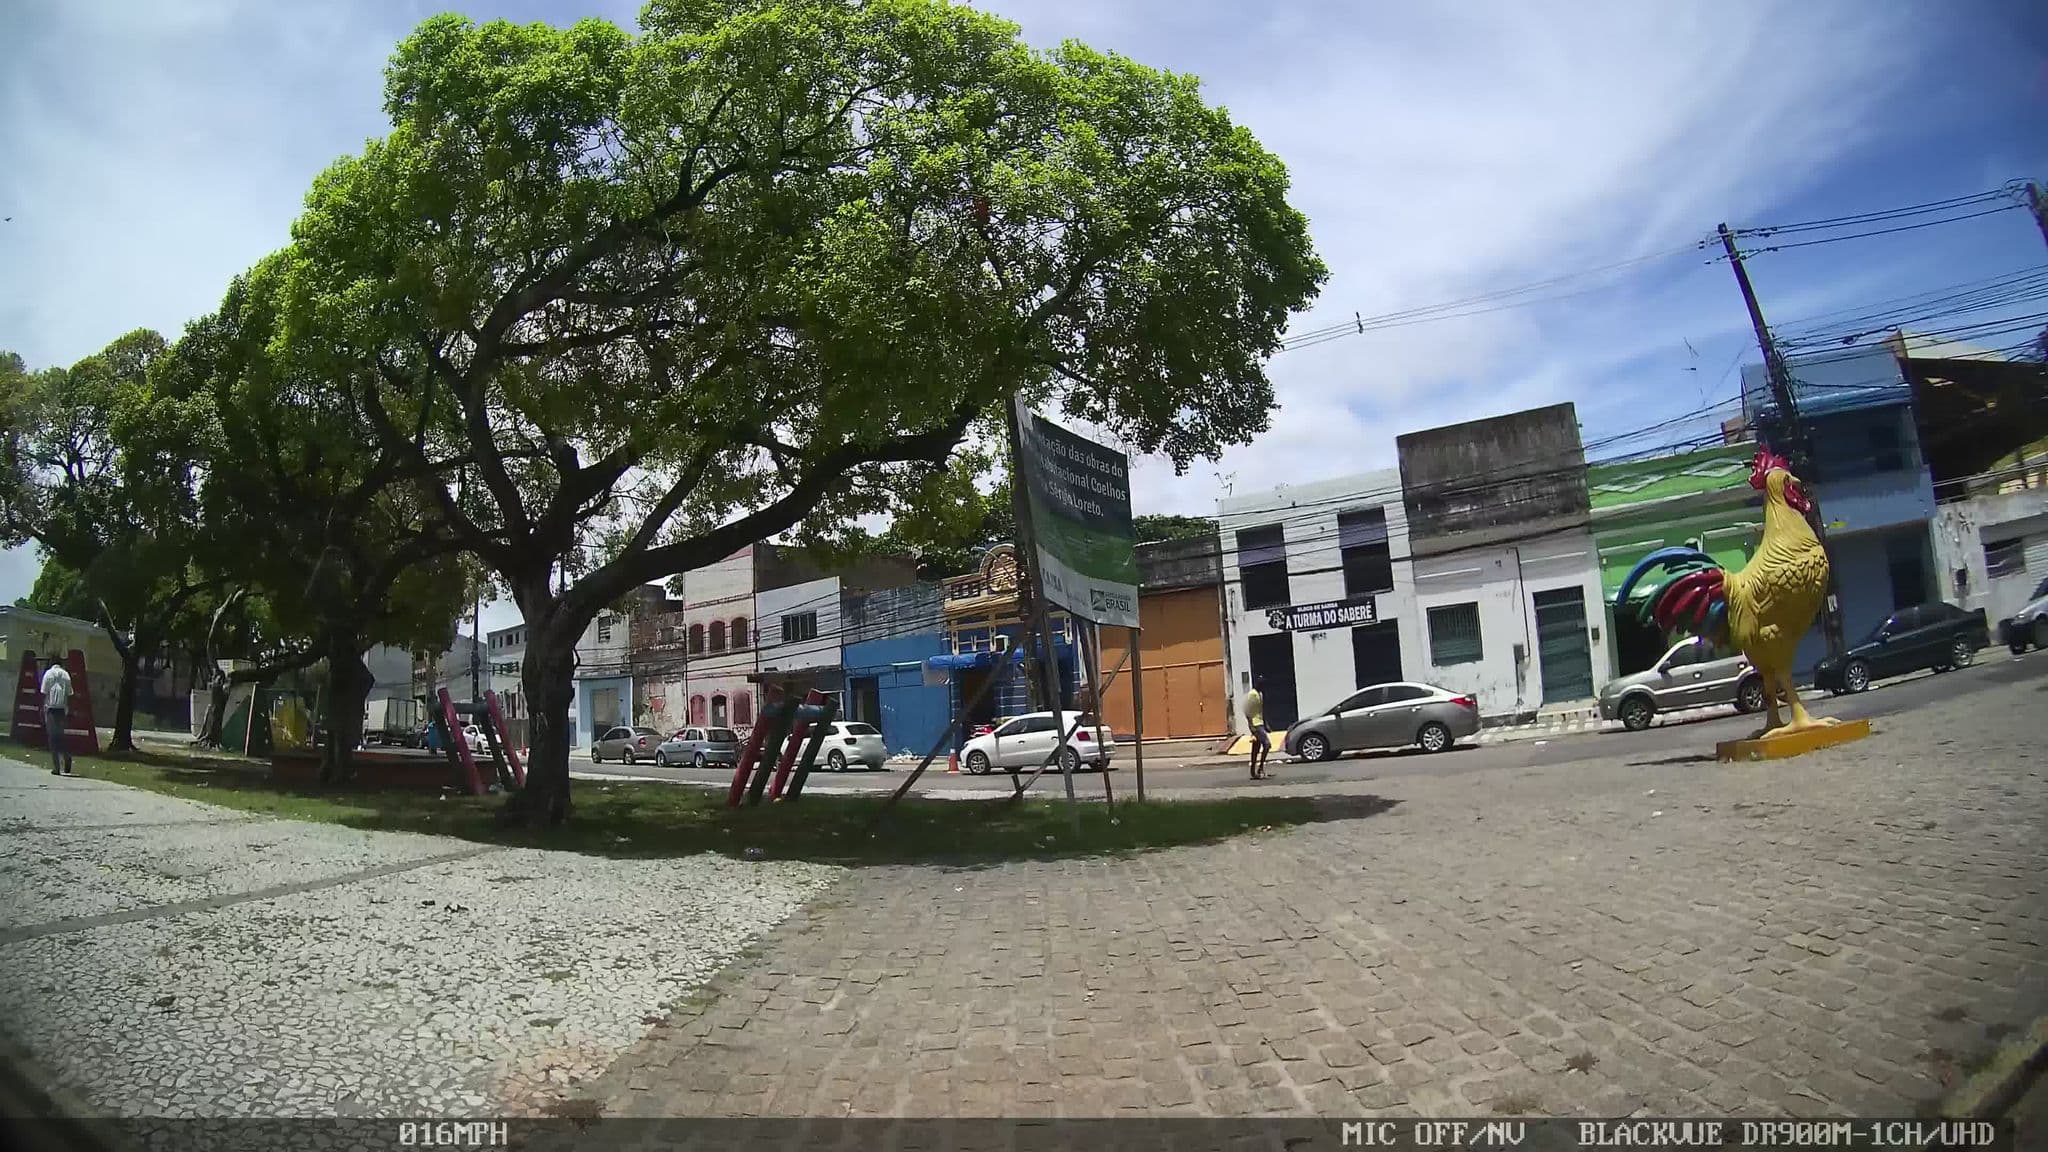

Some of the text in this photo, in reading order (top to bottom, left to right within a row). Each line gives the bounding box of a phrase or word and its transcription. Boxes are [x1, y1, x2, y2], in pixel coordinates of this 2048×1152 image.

[1068, 444, 1085, 464] das
[1086, 452, 1110, 474] obras
[1111, 462, 1123, 478] do
[1091, 477, 1127, 501] Coelhos
[1073, 494, 1104, 517] Loreto.
[1105, 598, 1131, 612] BRASIL
[1285, 601, 1373, 630] A TURMA DO SABERÉ
